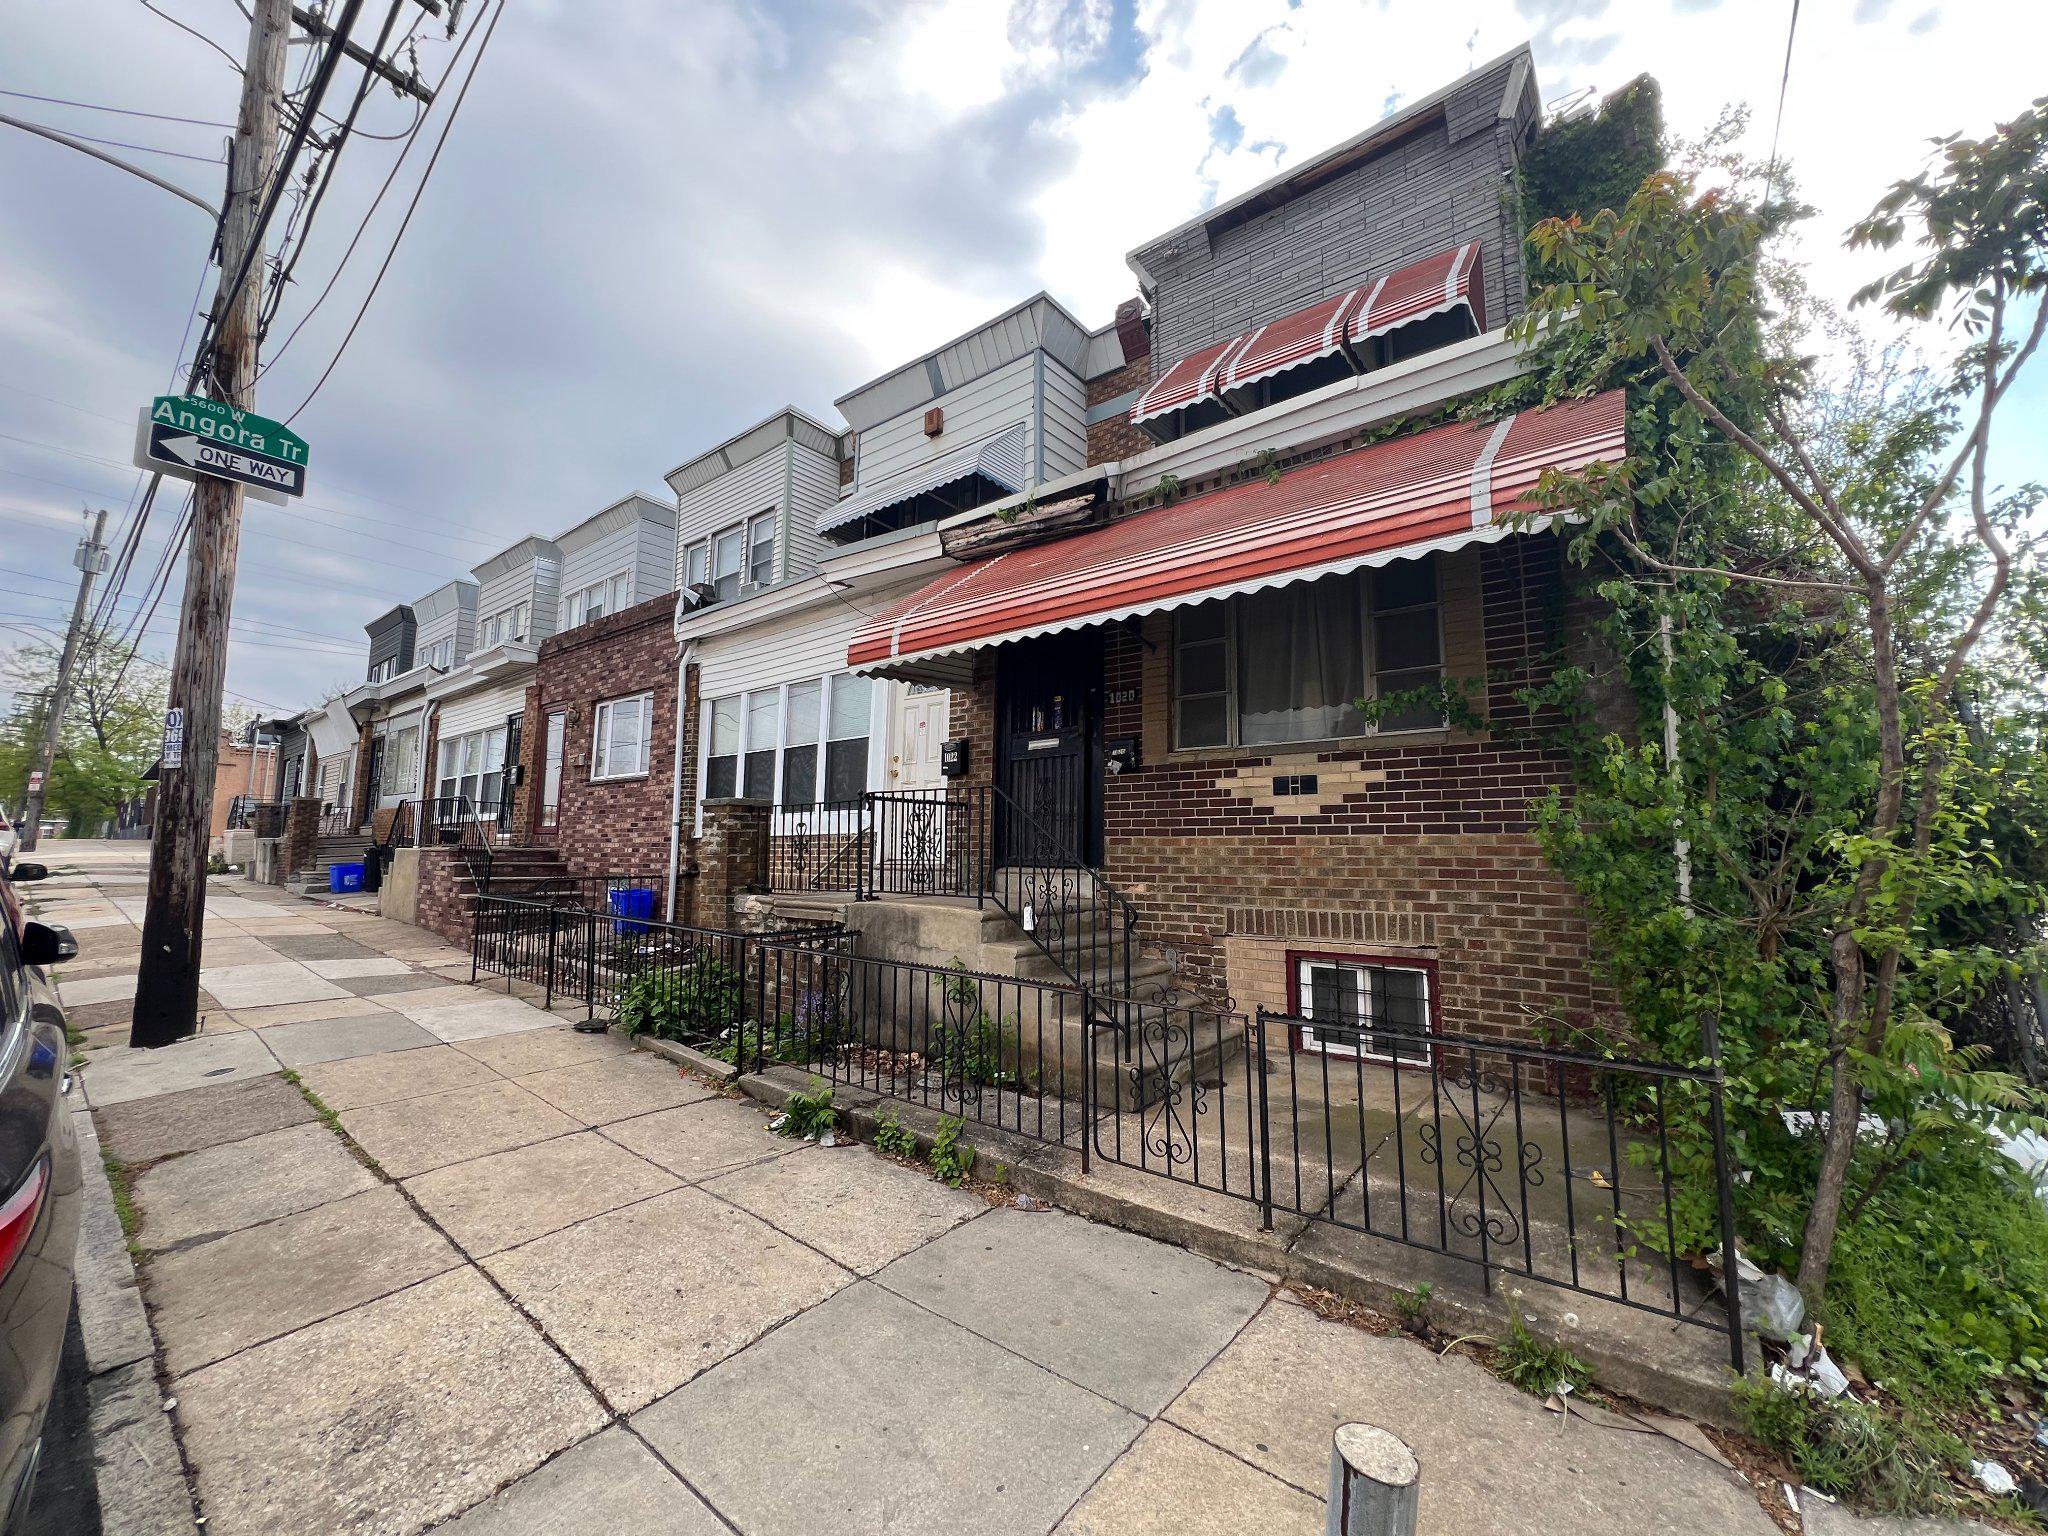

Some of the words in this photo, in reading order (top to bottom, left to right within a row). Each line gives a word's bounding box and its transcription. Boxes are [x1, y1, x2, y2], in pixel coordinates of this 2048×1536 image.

[190, 398, 225, 415] 5600
[231, 410, 246, 422] W
[153, 401, 265, 450] Angora
[278, 438, 302, 460] Tr
[200, 447, 241, 470] ONE
[249, 460, 290, 483] WAY
[1109, 690, 1135, 703] 1020
[944, 751, 958, 762] 1022
